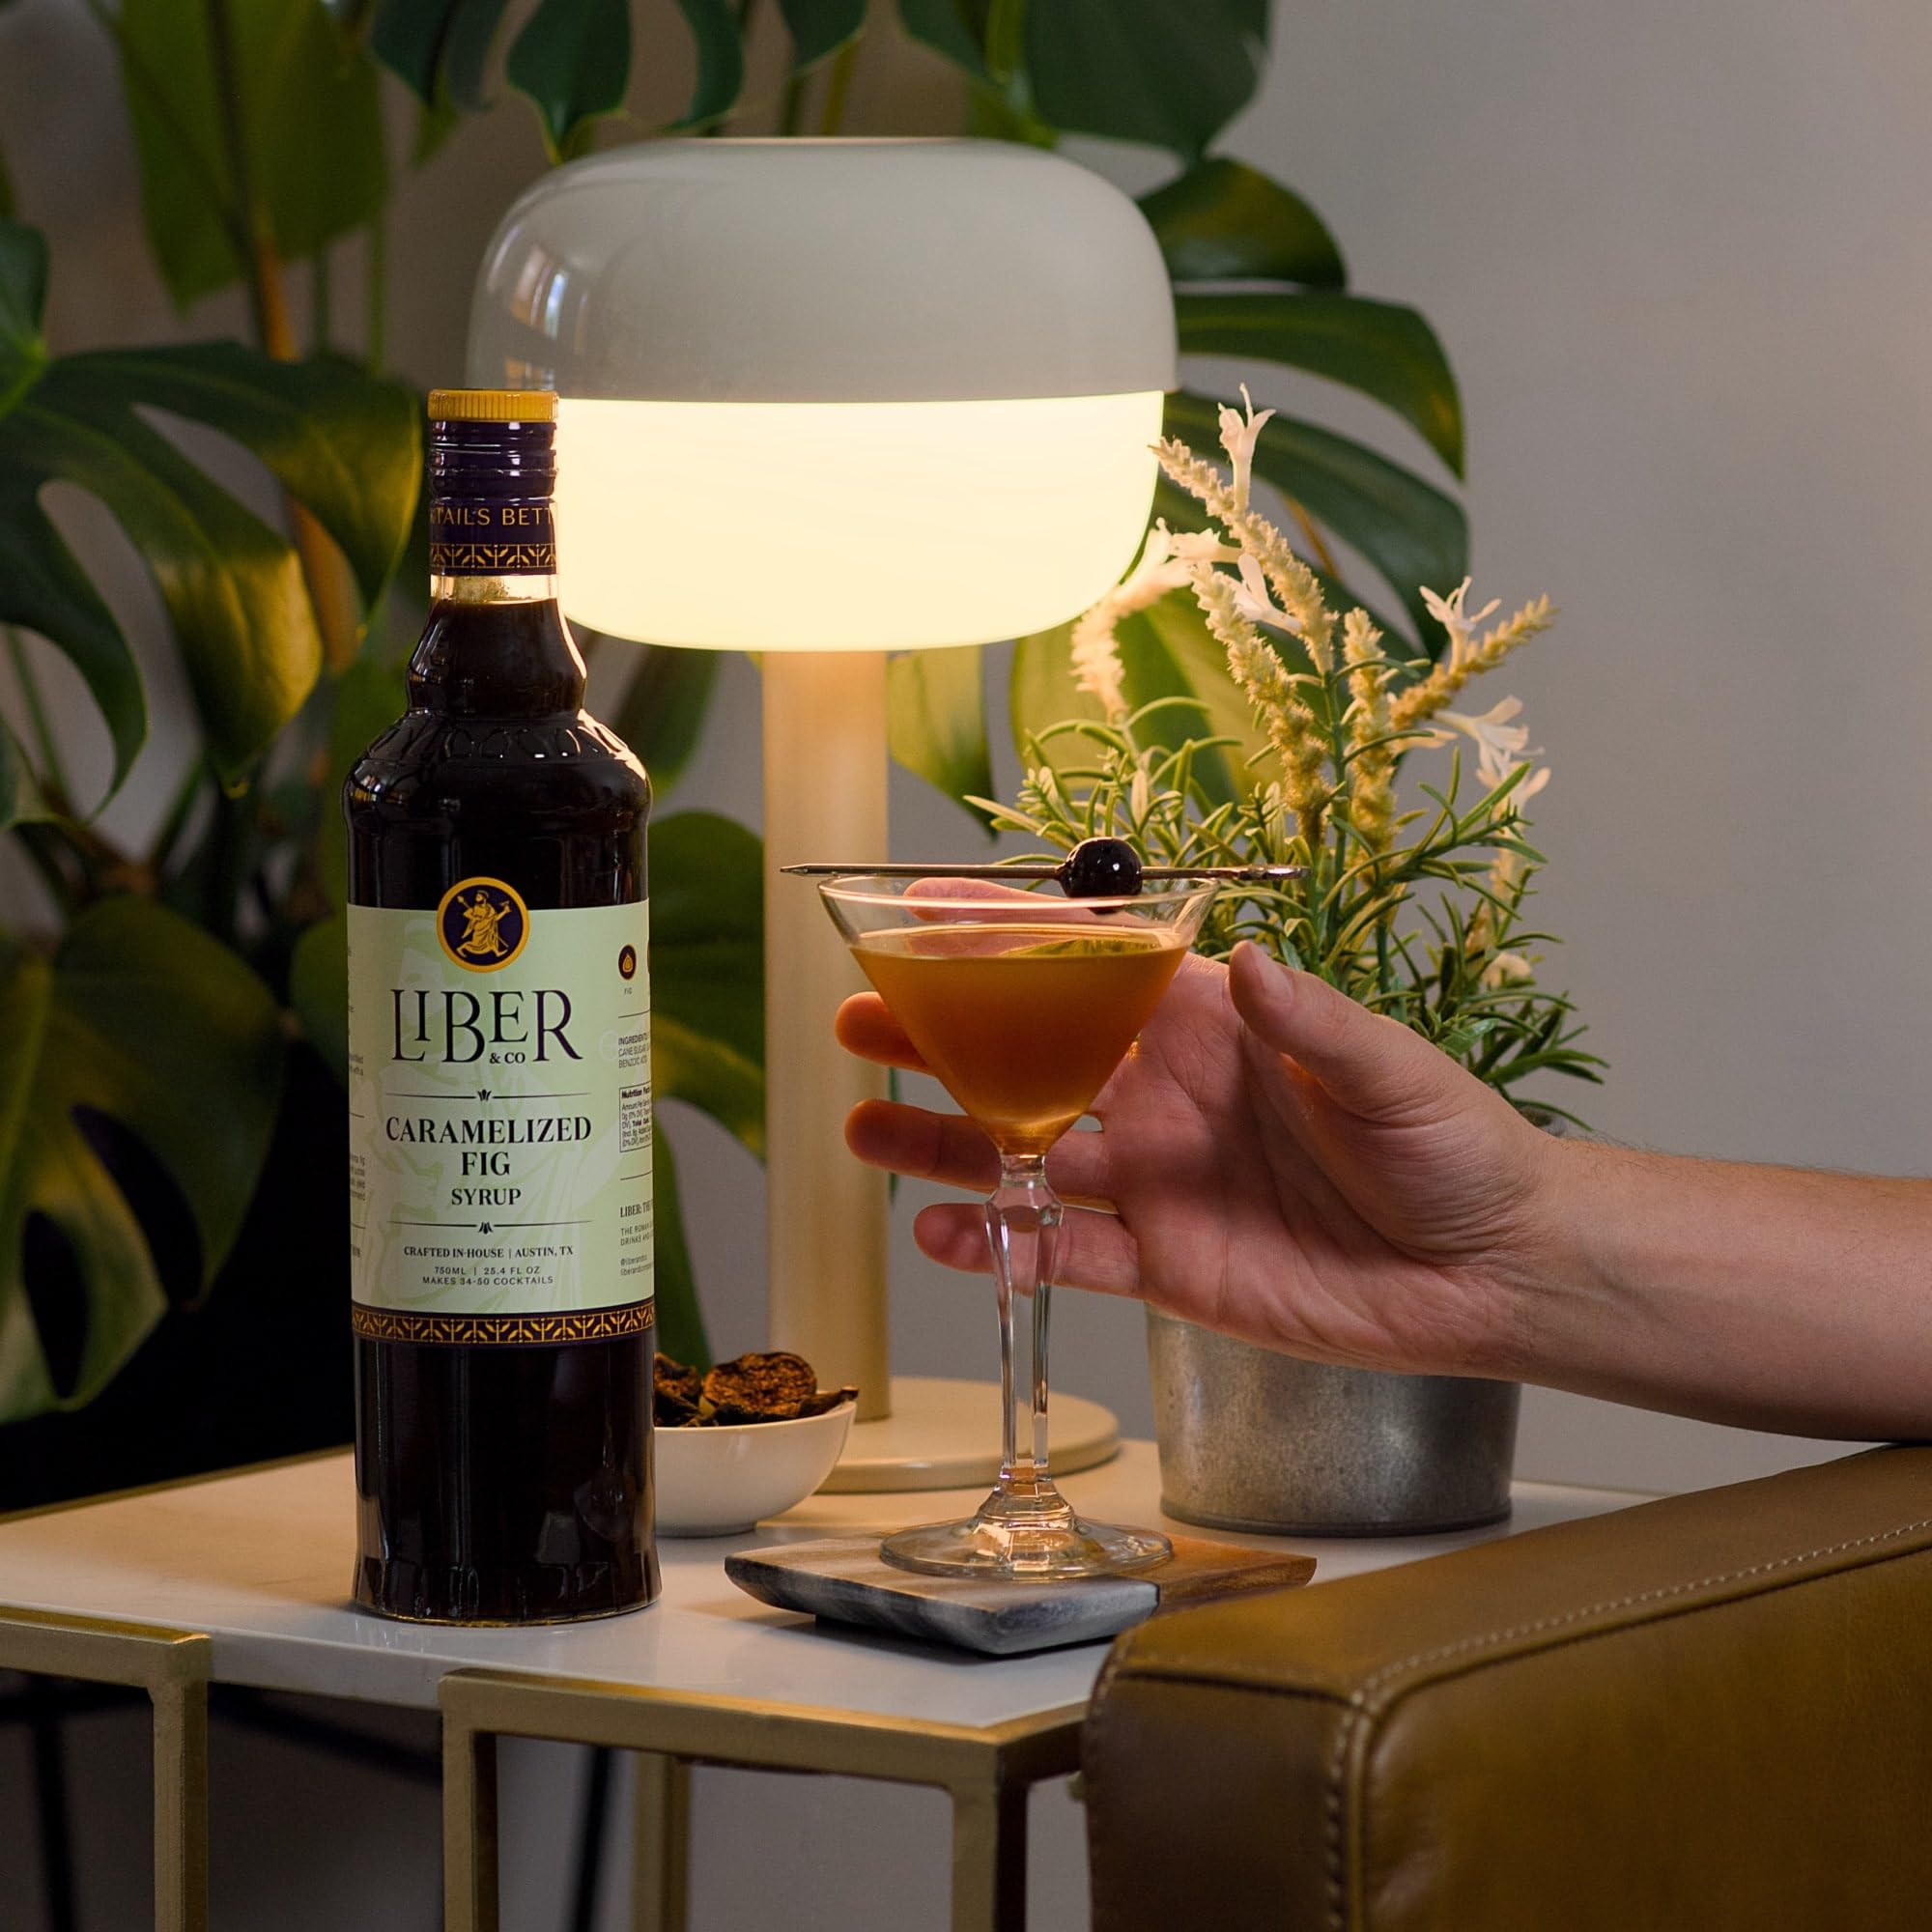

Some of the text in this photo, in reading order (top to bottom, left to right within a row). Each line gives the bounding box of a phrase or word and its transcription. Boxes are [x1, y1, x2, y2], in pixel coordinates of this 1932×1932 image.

[430, 507, 491, 526] TAILS
[389, 987, 583, 1063] LIBER
[489, 1051, 526, 1064] & CO
[386, 1116, 592, 1144] CARAMELIZED
[461, 1151, 511, 1176] FIG
[451, 1188, 522, 1207] SYRUP
[404, 1245, 574, 1259] CRAFTED IN-HOUSE AUSTIN, TX
[435, 1265, 541, 1275] 750ML 25.4 FL OZ
[422, 1275, 554, 1286] MAKES 34-50 COCKTAILS
